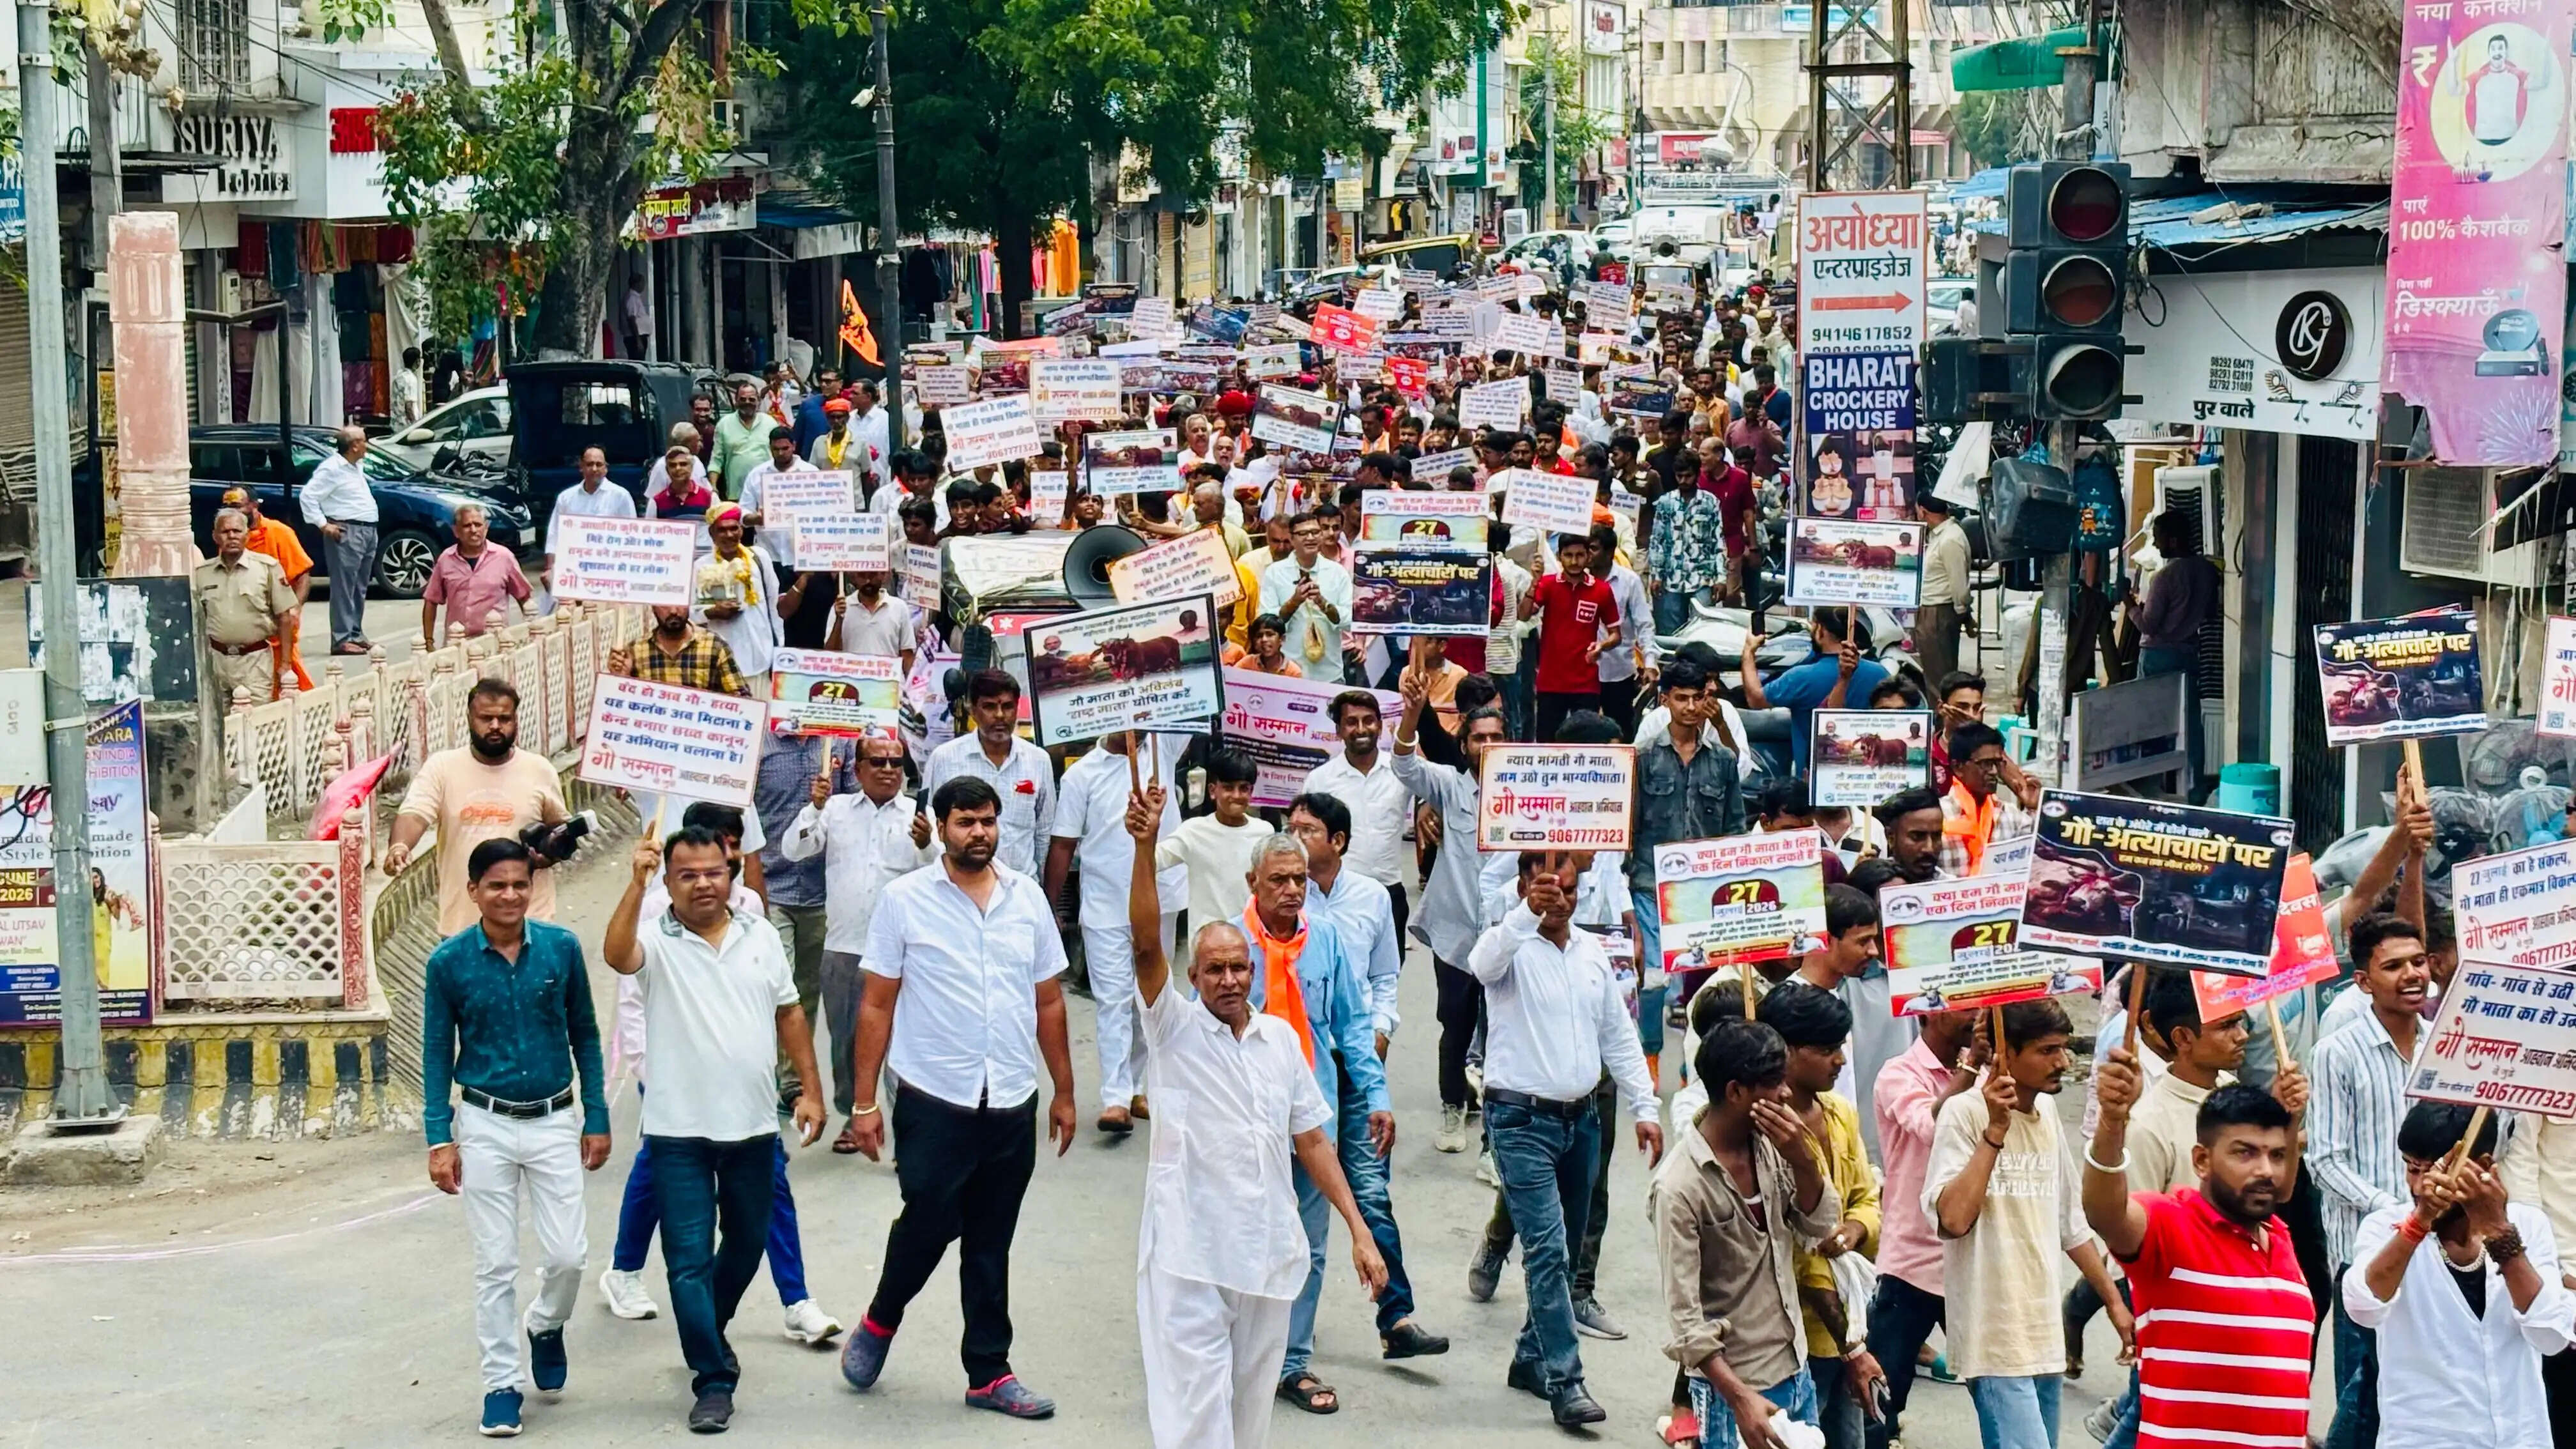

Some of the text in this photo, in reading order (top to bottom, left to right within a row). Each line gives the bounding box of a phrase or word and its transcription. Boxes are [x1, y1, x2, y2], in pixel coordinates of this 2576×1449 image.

[2414, 3, 2453, 22] नया
[180, 116, 282, 158] SURIYA
[671, 192, 691, 221] साड़ी
[2402, 196, 2428, 214] पाएं
[1805, 201, 1920, 252] अयोध्या
[2400, 213, 2530, 241] 100% कैशबैक
[1813, 250, 1912, 280] एन्टरप्राइजेज
[1813, 326, 1912, 341] 9414617852
[1809, 356, 1911, 388] BHARAT
[1809, 389, 1910, 410] CROCKERY
[2193, 398, 2255, 420] पुर वाले
[1825, 411, 1896, 430] HOUSE
[1414, 521, 1438, 534] 27
[1459, 567, 1480, 579] पर
[2446, 634, 2471, 652] पर
[618, 681, 637, 694] बंद
[641, 686, 654, 697] हो
[658, 691, 680, 702] अब
[822, 682, 847, 698] 27
[1087, 692, 1116, 705] माता
[1118, 686, 1135, 698] को
[604, 696, 753, 731] यह कलंक अब मिटाना है
[601, 711, 629, 726] केन्द्र
[707, 732, 749, 749] कानून,
[1252, 716, 1308, 739] सम्मान
[105, 749, 135, 760] INDIA
[603, 730, 622, 742] यह
[625, 735, 679, 752] अभियान
[683, 744, 726, 760] चलाना
[620, 756, 675, 779] सम्मान
[1506, 755, 1534, 766] न्याय
[1537, 753, 1570, 766] मांगती
[1521, 770, 1537, 783] उठो
[1542, 772, 1560, 787] तुम
[1562, 770, 1625, 783] भाग्यविधाता।
[1517, 797, 1567, 821] सम्मान
[92, 830, 133, 841] made
[1548, 829, 1623, 843] 9067777323
[2060, 815, 2276, 869] गौ-अत्याचारों पर
[1697, 849, 1716, 860] क्या
[1720, 846, 1737, 857] हम
[1754, 843, 1780, 854] माता
[1782, 839, 1792, 849] के
[1795, 836, 1816, 848] लिए
[1691, 864, 1708, 873] एक
[1712, 859, 1733, 871] दिन
[1735, 856, 1773, 868] निकाल
[1776, 851, 1804, 862] सकते
[2470, 852, 2570, 886] 27 जुलाई का है संकल्प,
[1729, 881, 1761, 905] 27
[1932, 892, 1956, 902] क्या
[1961, 889, 1982, 899] हम
[2474, 891, 2496, 907] माता
[2499, 885, 2508, 902] ही
[2512, 881, 2545, 900] एकमात्र
[1746, 901, 1777, 914] 2026
[1925, 900, 1977, 916] एक दिन
[1974, 923, 2012, 947] 27
[2485, 917, 2529, 950] सम्मान
[2501, 975, 2532, 993] गांव
[2532, 977, 2546, 995] से
[2481, 1002, 2516, 1019] माता
[2517, 1004, 2540, 1022] का
[2540, 1006, 2557, 1024] हो
[2464, 1036, 2522, 1070] सम्मान
[2474, 1080, 2576, 1110] 9067777323
